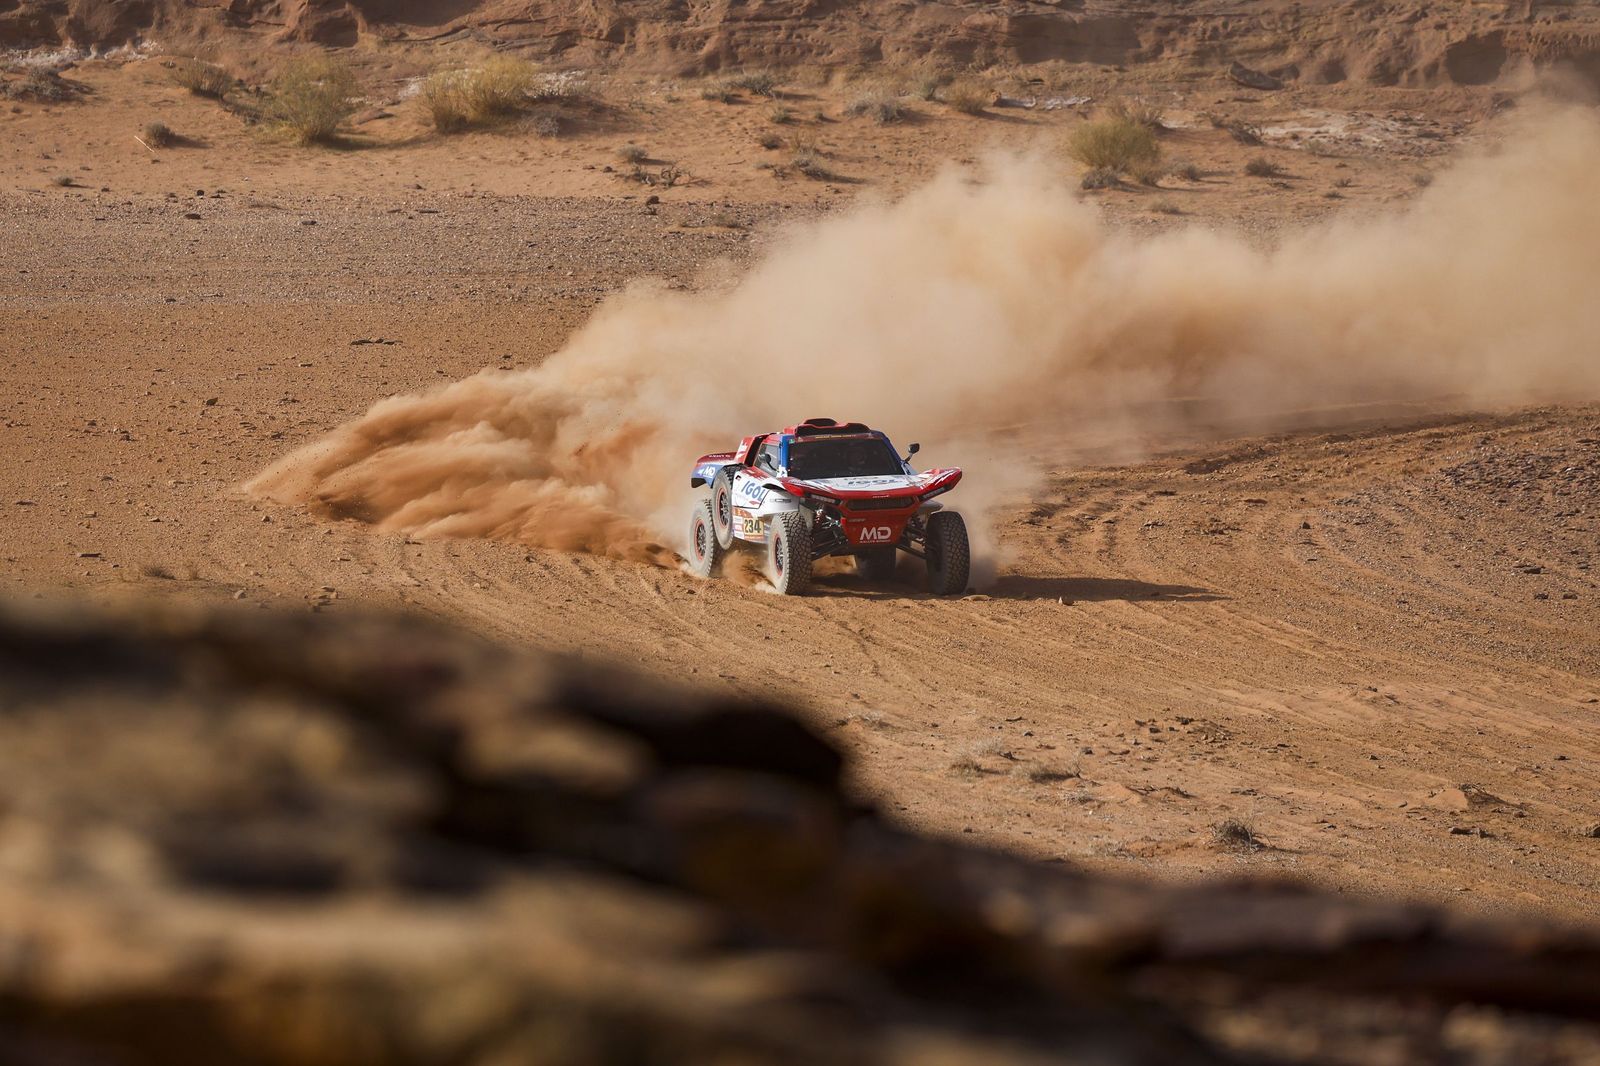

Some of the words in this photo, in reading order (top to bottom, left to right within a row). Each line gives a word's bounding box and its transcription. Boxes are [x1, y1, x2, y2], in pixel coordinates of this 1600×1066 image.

[741, 480, 765, 502] IGOL
[744, 519, 762, 533] 234
[859, 526, 892, 541] MD
